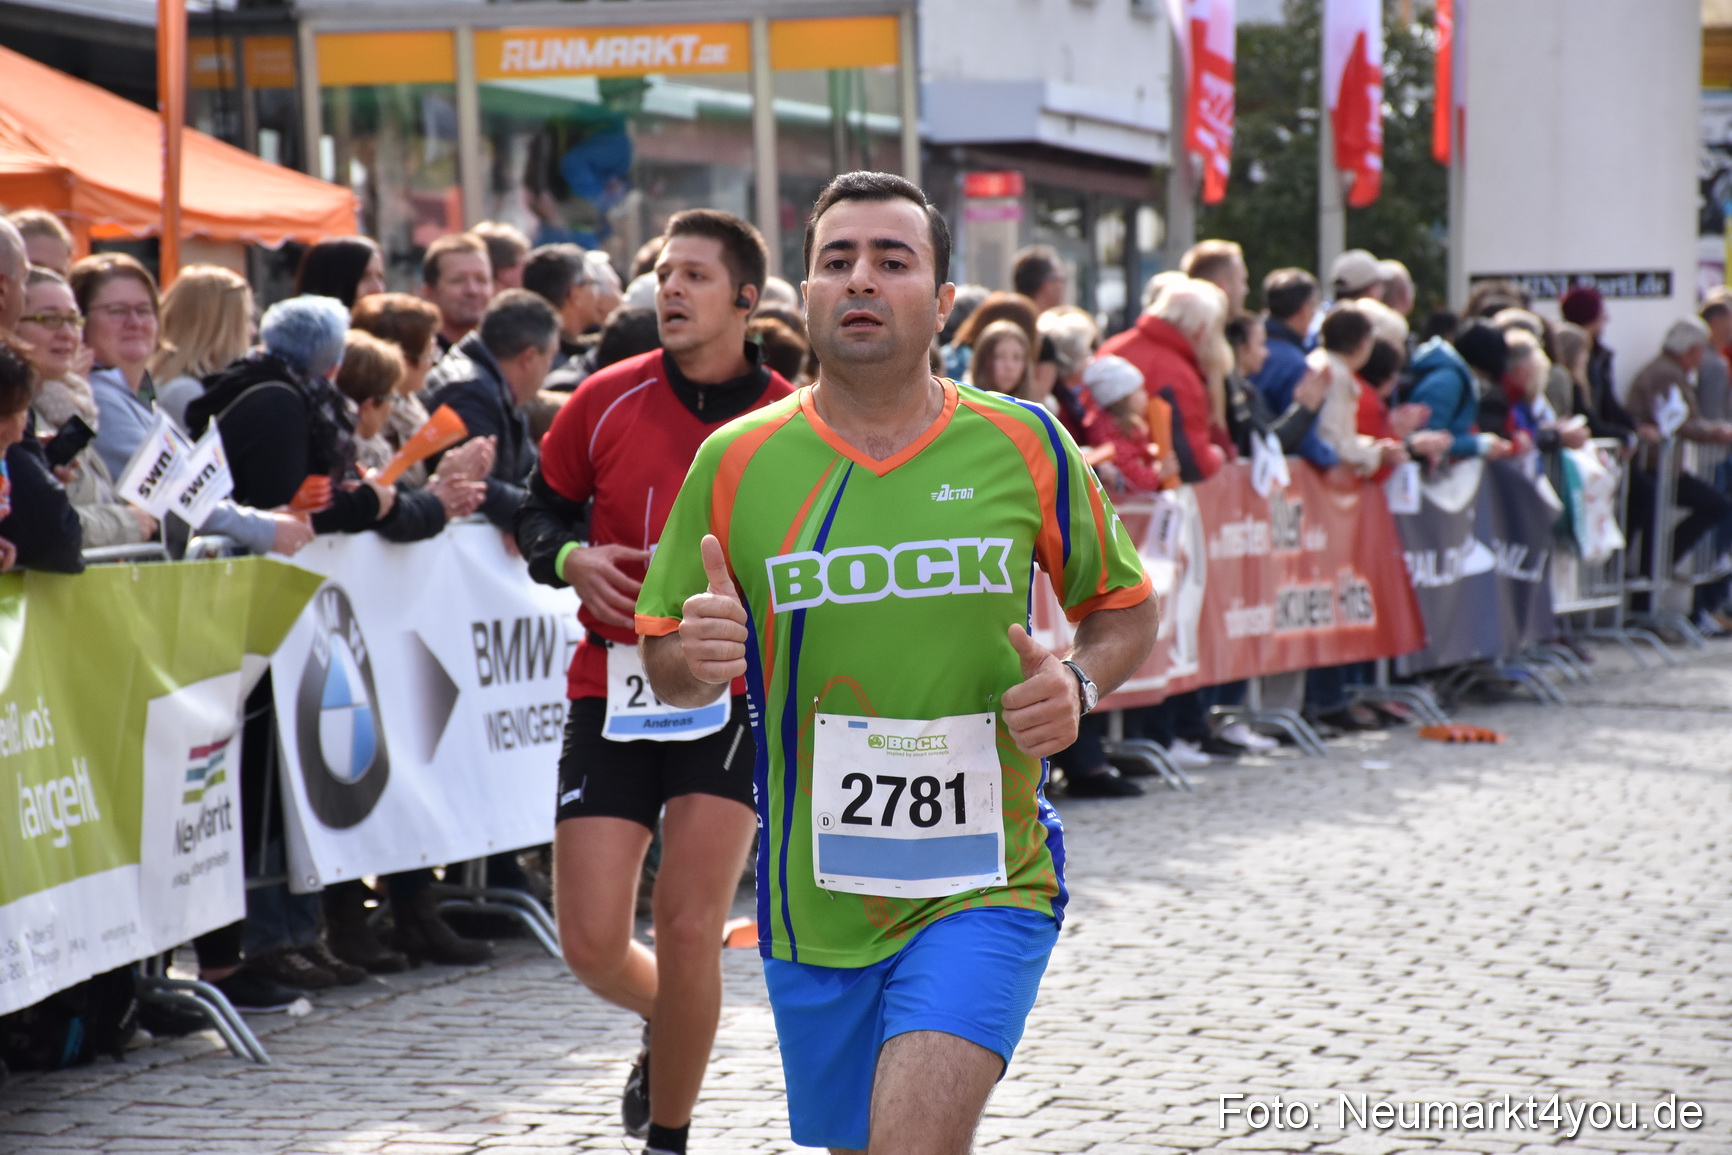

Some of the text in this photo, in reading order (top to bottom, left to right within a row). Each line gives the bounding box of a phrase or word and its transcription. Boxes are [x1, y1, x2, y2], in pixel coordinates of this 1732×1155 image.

[501, 34, 729, 71] RUNMARKT.DE
[138, 450, 172, 498] swn
[180, 463, 216, 507] swn
[765, 537, 1014, 614] BOCK
[471, 616, 556, 687] BMW
[483, 702, 564, 754] WENIGER
[643, 717, 693, 729] Andreas
[887, 734, 948, 752] BOCK
[822, 816, 829, 826] D
[841, 772, 966, 828] 2781
